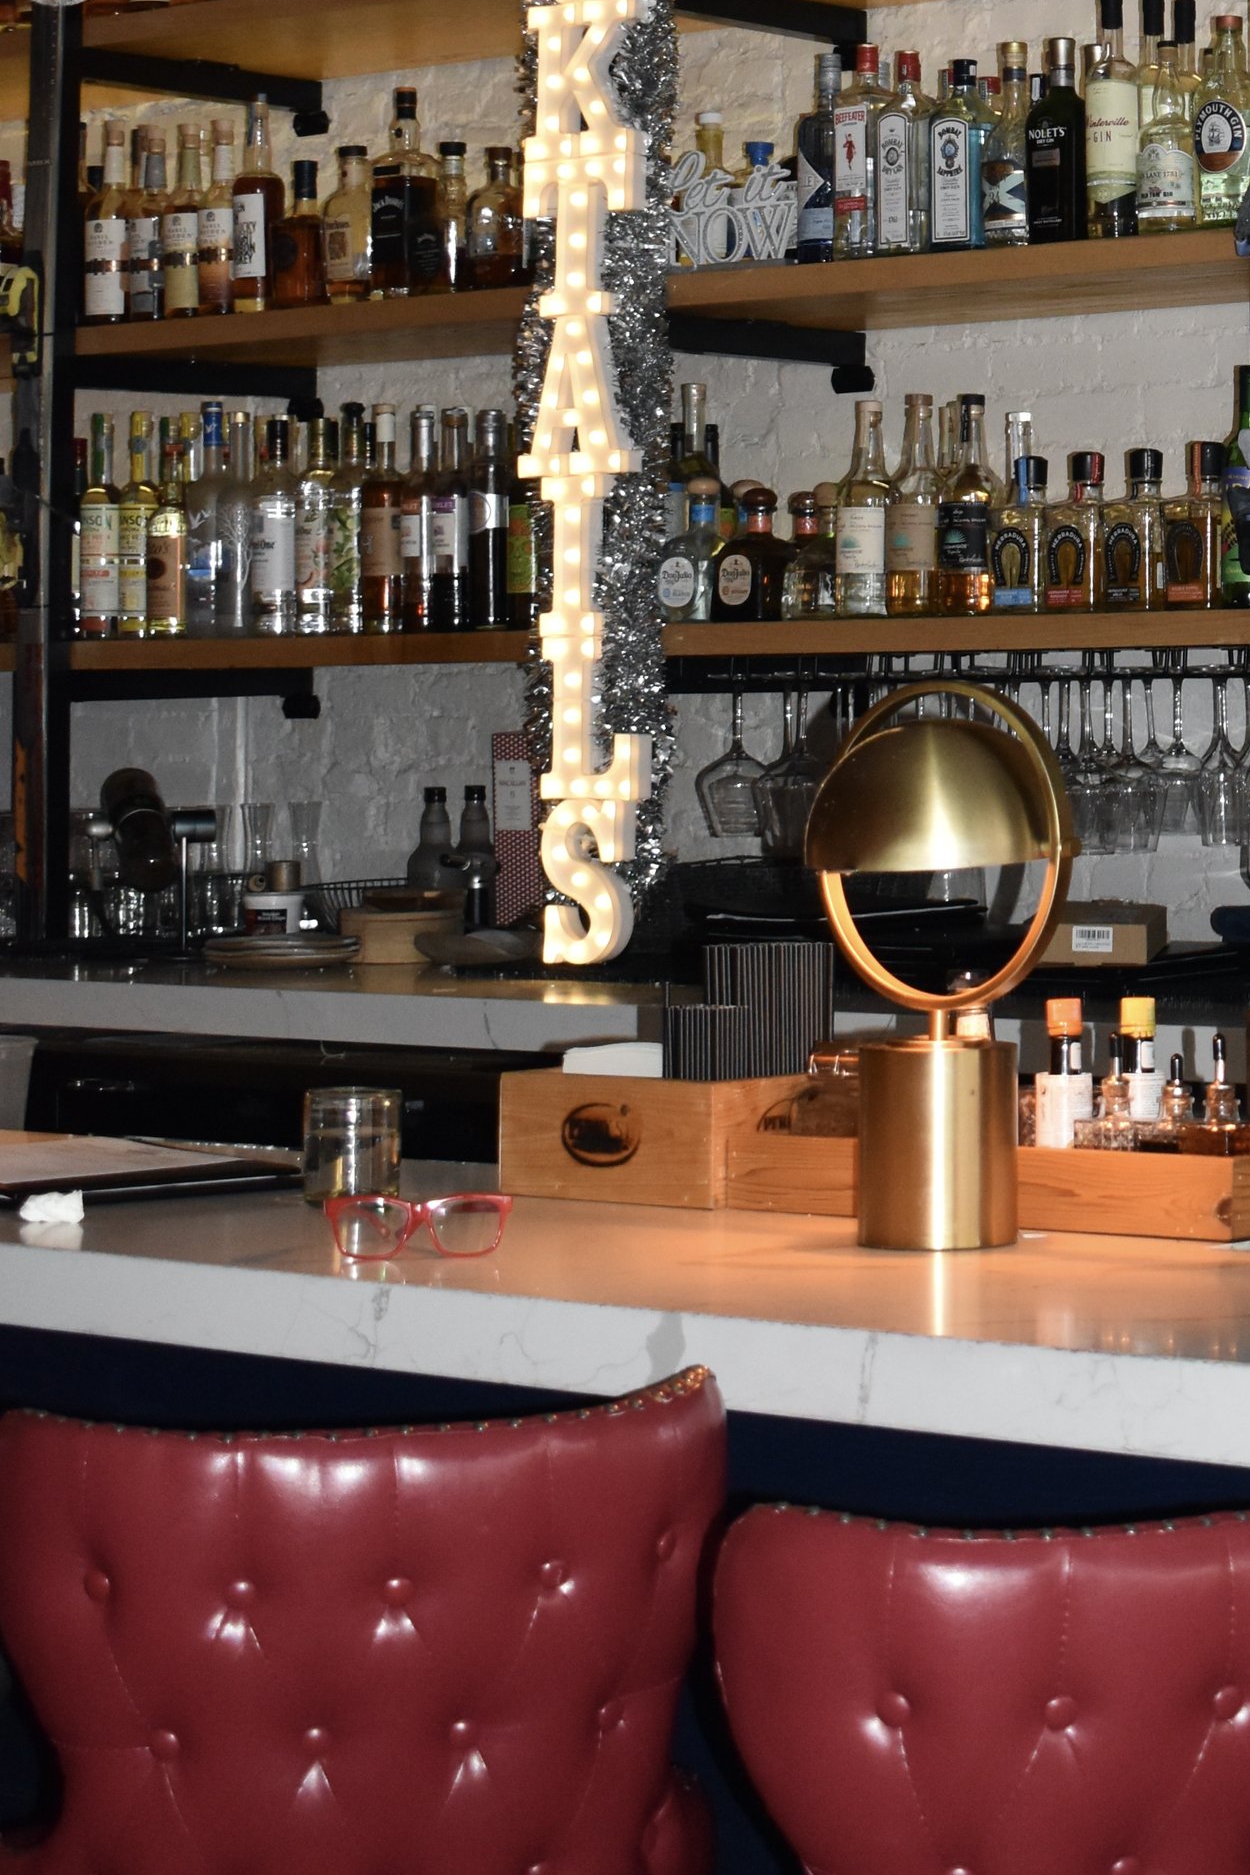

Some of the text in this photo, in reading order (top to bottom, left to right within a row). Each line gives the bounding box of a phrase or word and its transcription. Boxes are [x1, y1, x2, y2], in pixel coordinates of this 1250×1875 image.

[835, 111, 866, 125] BEEFEATER
[1194, 102, 1243, 141] PLYMOUTH GIN
[937, 126, 962, 141] BOMBAY
[1028, 125, 1067, 140] NOLET'S
[1093, 131, 1112, 143] GIN
[936, 165, 964, 178] SAPPHIRE
[994, 530, 1027, 551] HERRADURA
[1051, 530, 1084, 550] HERRADURA
[1108, 528, 1139, 546] HERRADURA
